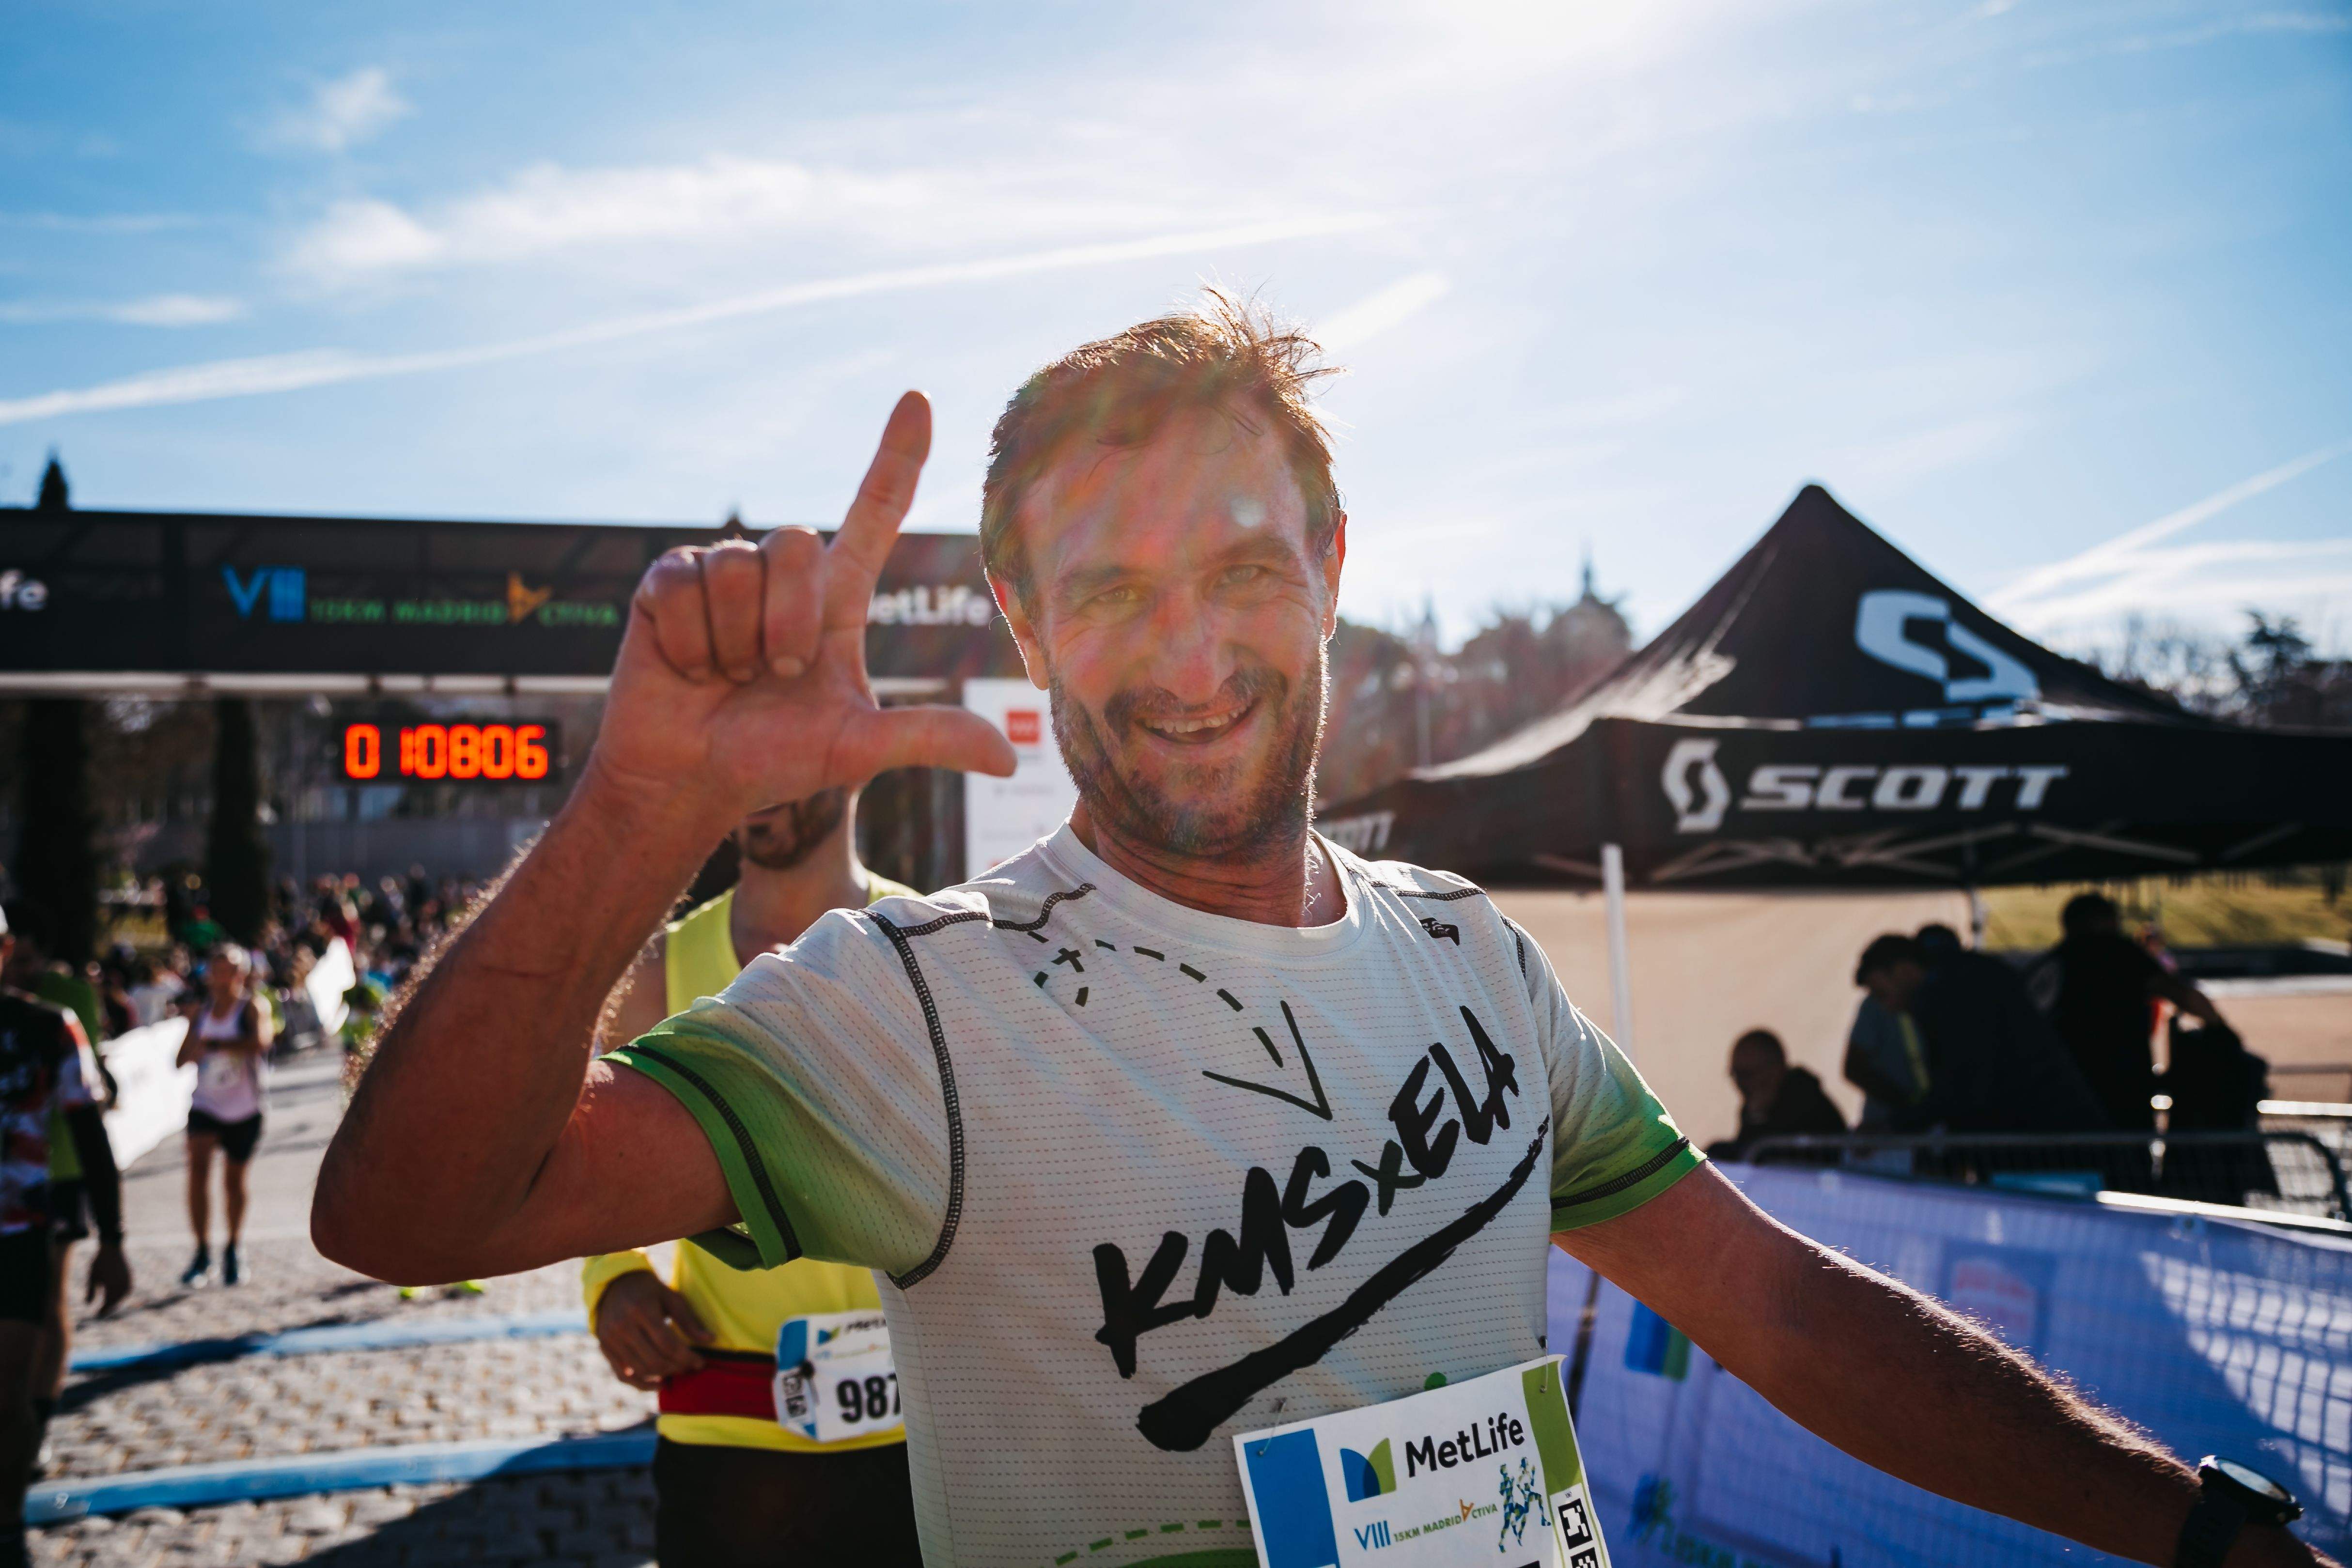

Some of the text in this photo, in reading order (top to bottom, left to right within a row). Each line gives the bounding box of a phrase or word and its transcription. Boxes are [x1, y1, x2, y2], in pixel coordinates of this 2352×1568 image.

[1739, 764, 2070, 810] SCOTT
[1405, 1412, 1525, 1478] MetLife
[1354, 1520, 1391, 1551] VIII
[1394, 1527, 1420, 1542] 15KM
